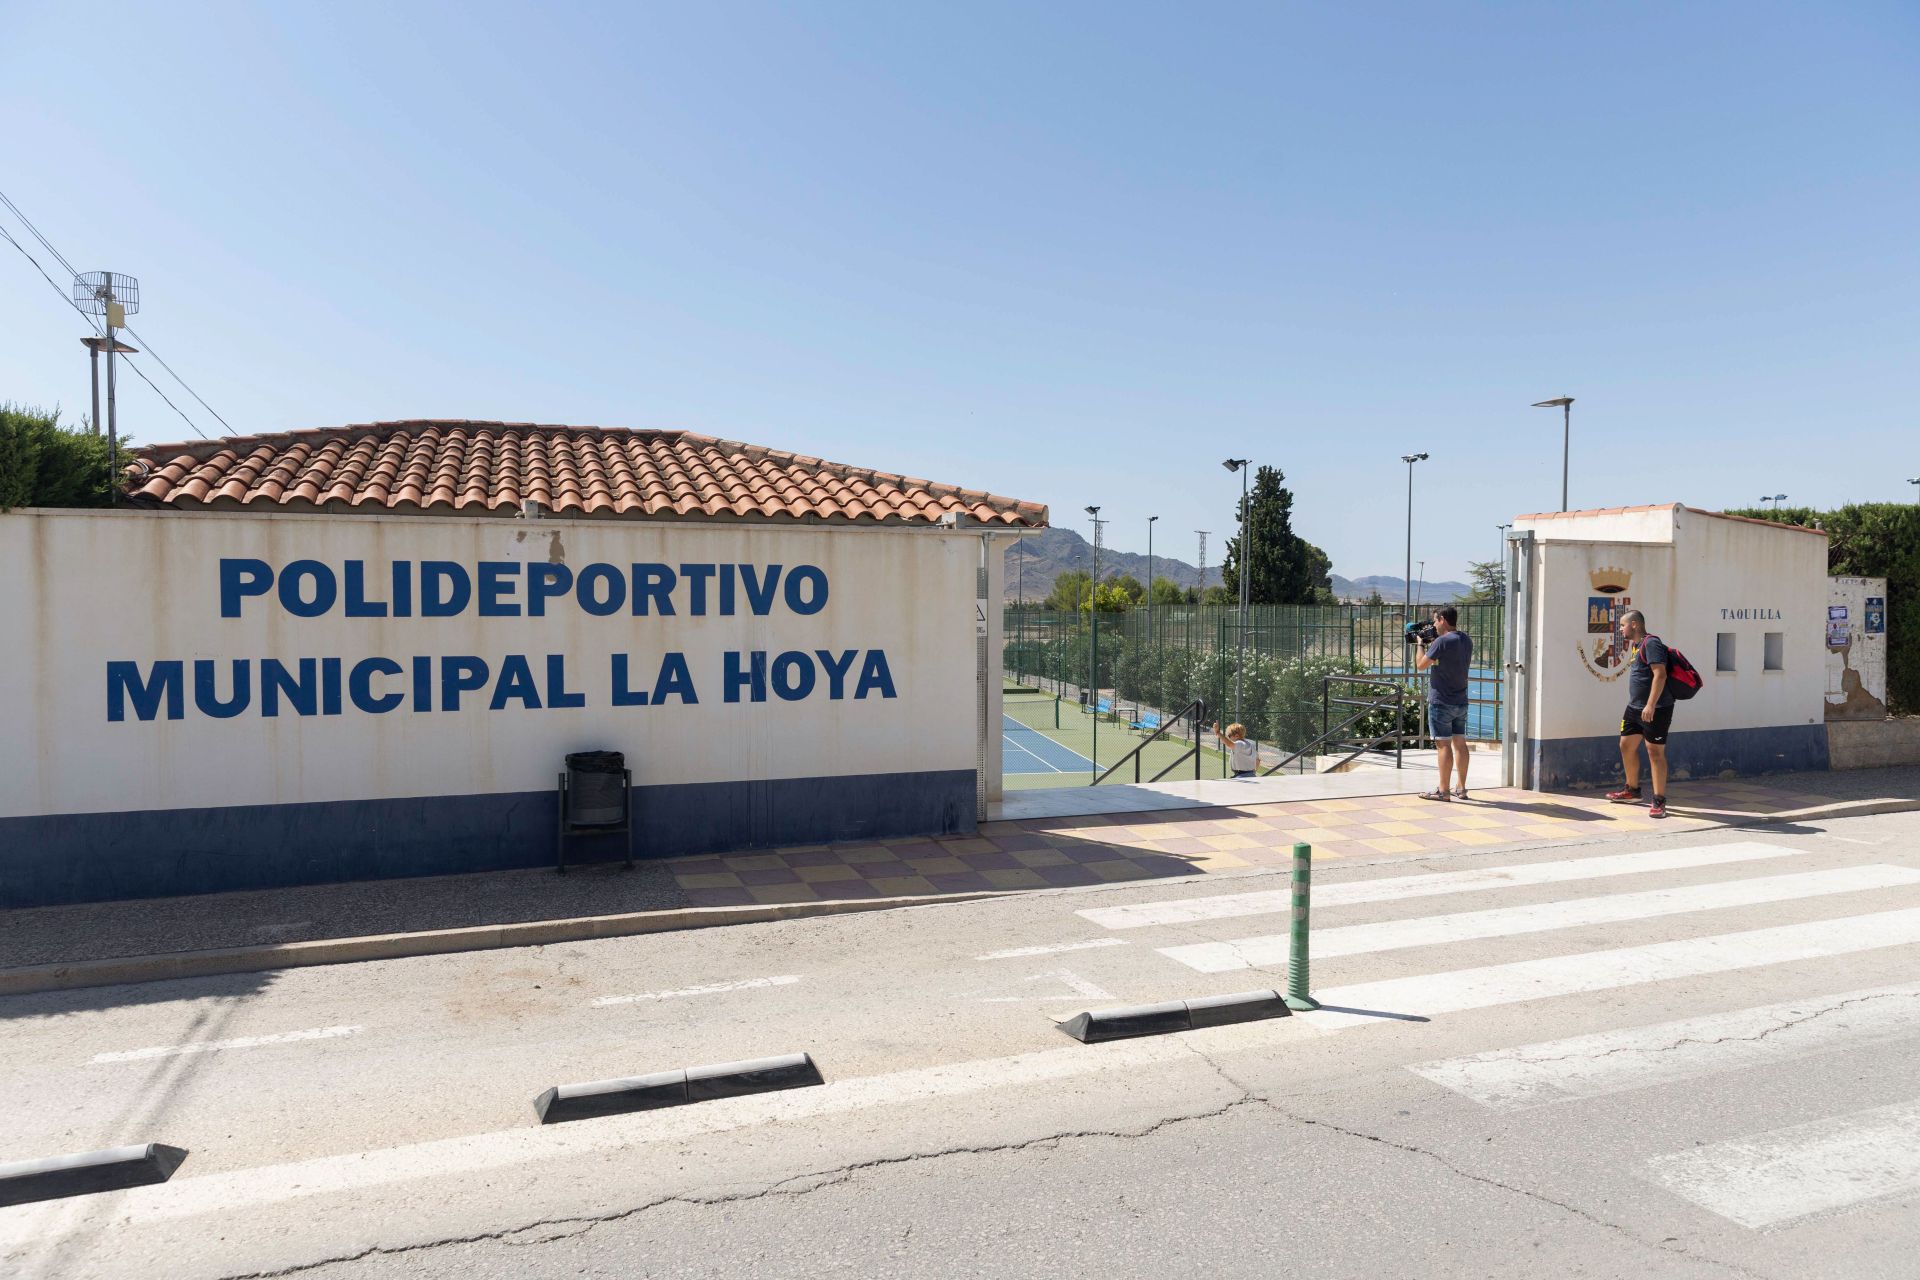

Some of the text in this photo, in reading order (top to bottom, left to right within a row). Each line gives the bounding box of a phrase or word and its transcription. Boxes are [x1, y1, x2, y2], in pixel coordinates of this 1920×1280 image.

[220, 558, 829, 618] POLIDEPORTIVO
[1720, 608, 1784, 620] TAQUILLA
[107, 650, 897, 721] MUNICIPAL LA HOYA
